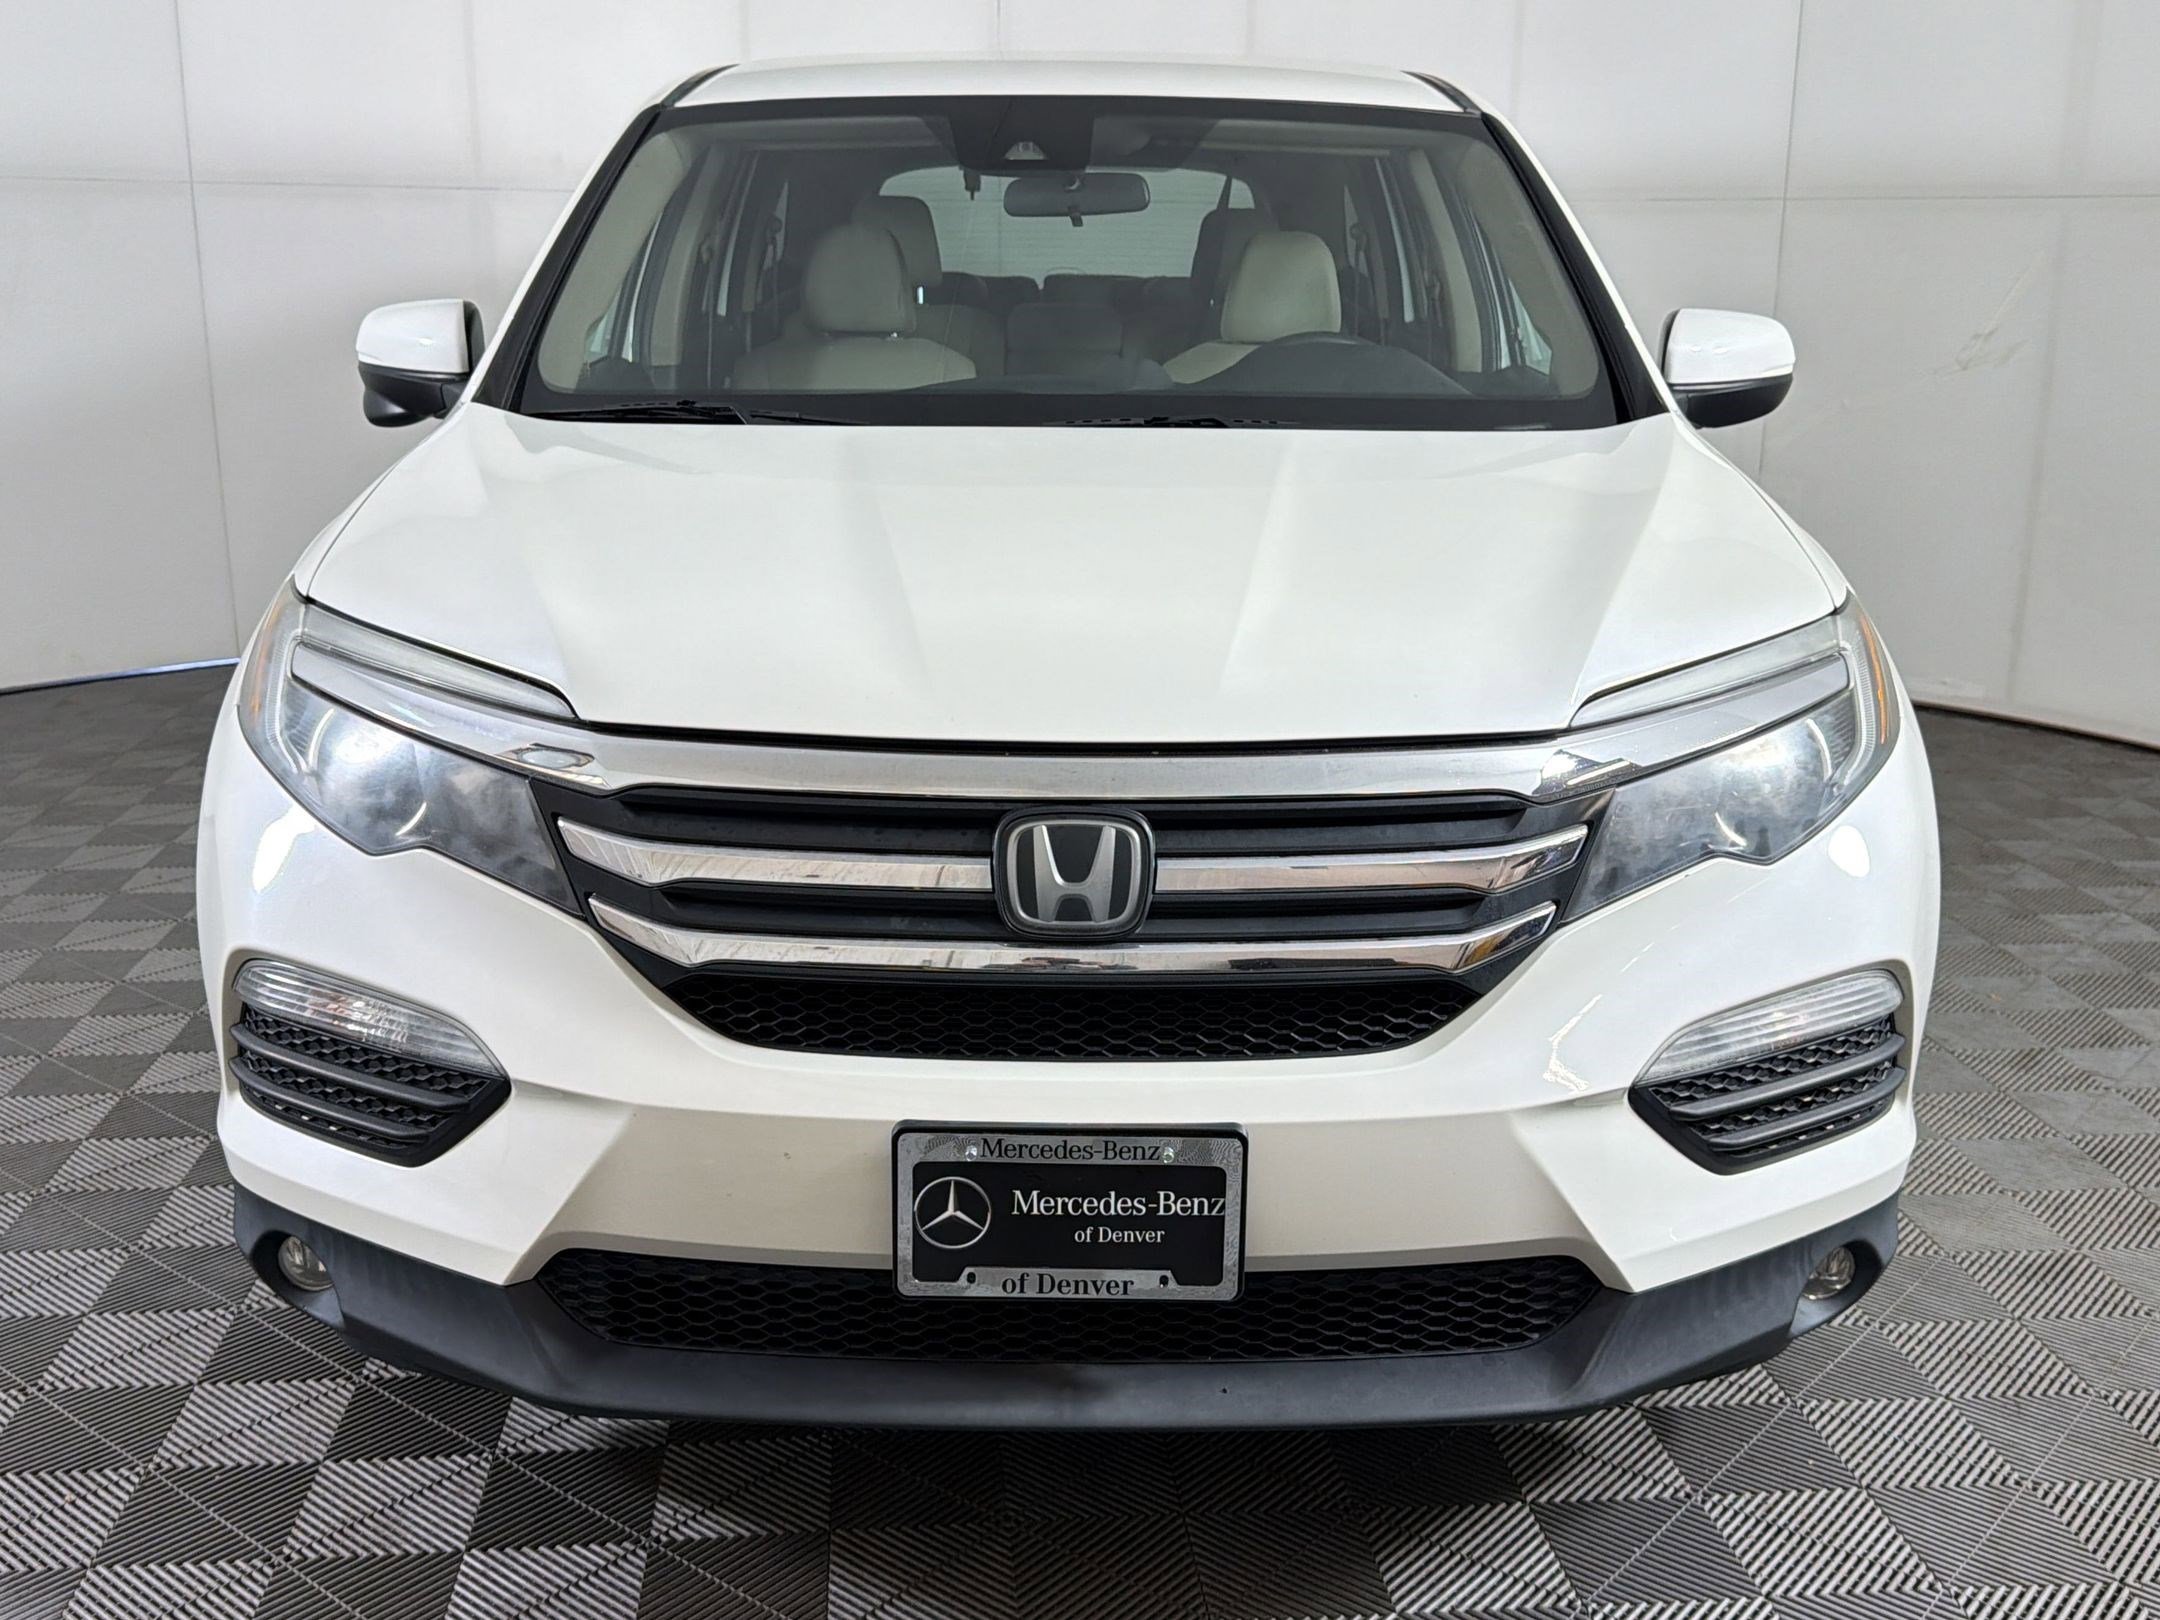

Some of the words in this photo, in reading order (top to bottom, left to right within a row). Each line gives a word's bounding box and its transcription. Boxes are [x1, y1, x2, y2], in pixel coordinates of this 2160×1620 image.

[980, 1137, 1161, 1162] Mercedes-Benz
[1011, 1189, 1226, 1217] Mercedes-Benz
[1074, 1226, 1094, 1243] of
[1098, 1226, 1165, 1243] Denver
[1002, 1273, 1028, 1295] of
[1036, 1274, 1135, 1297] Denver
